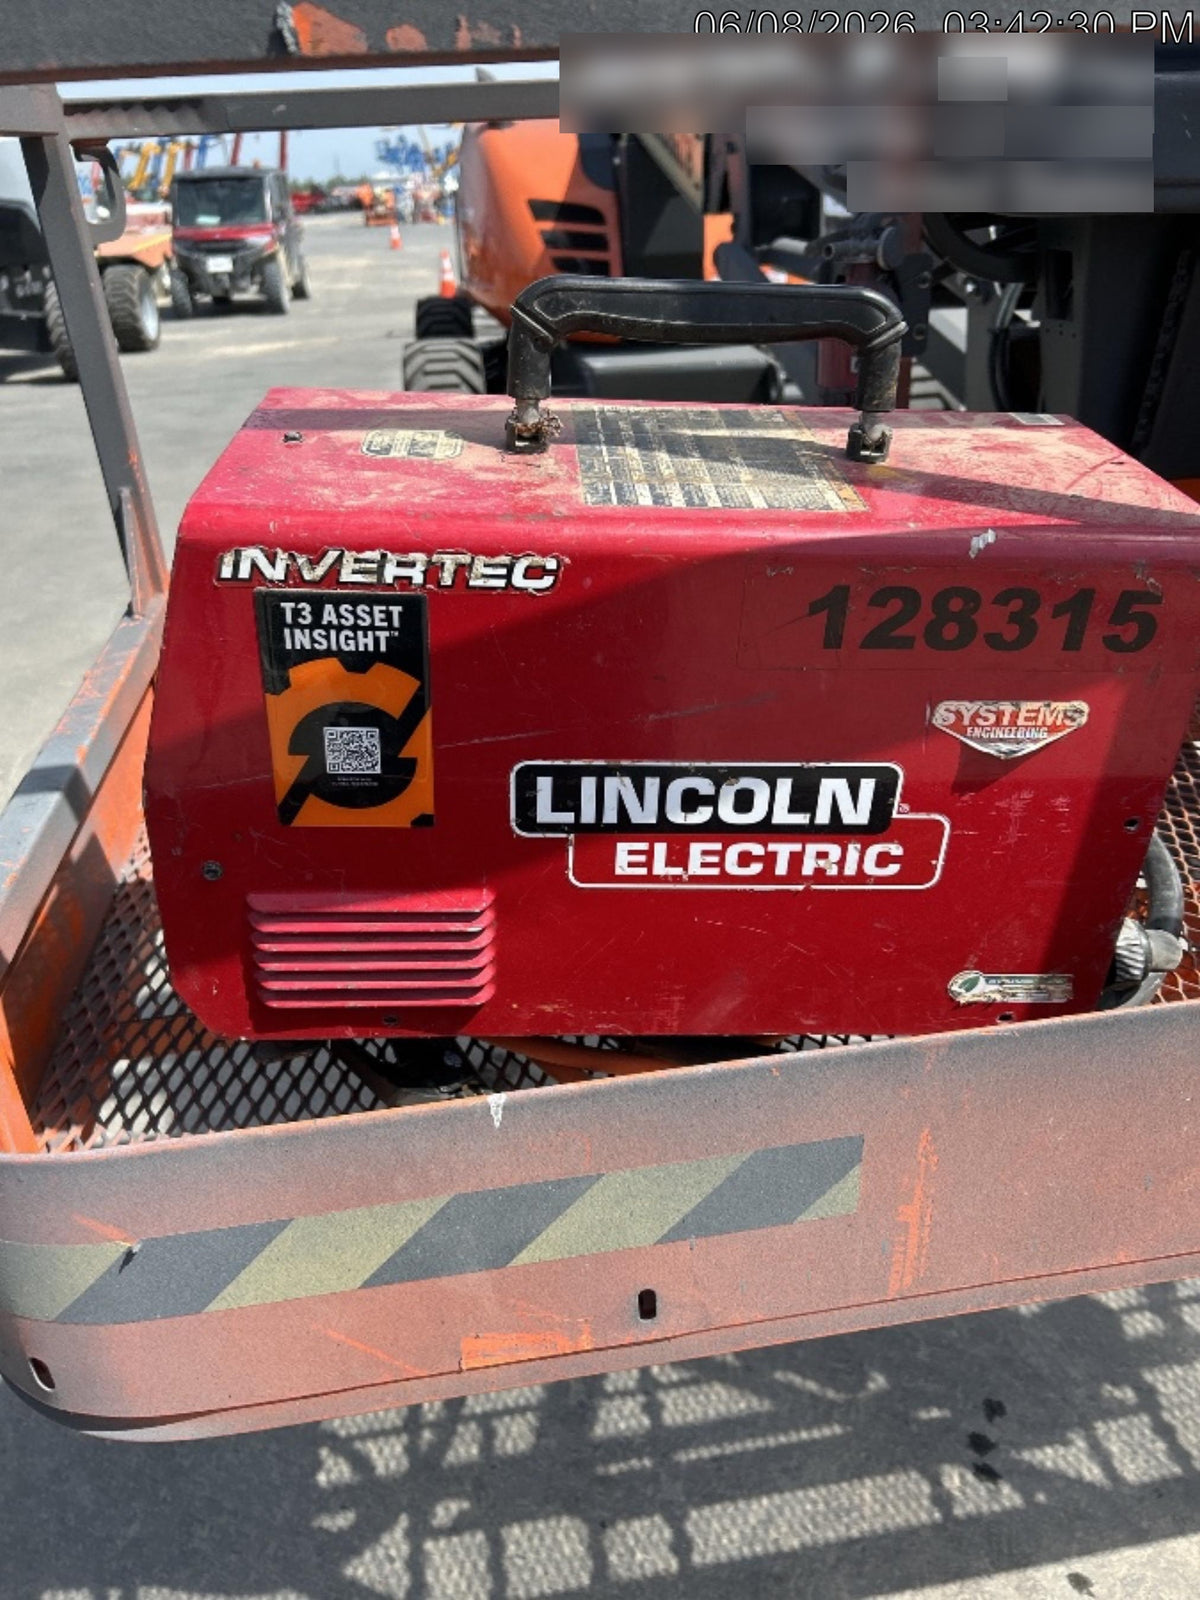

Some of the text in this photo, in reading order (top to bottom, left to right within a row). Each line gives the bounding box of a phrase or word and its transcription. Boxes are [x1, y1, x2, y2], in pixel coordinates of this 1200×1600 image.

[217, 548, 560, 590] INVERTEC
[280, 602, 403, 628] T3 ASSET
[807, 584, 1164, 653] 128315
[935, 702, 1087, 727] SYSTEMS
[966, 727, 1048, 738] ENGINEERING
[536, 776, 876, 826] LINCOLN
[615, 842, 904, 877] ELECTRIC
